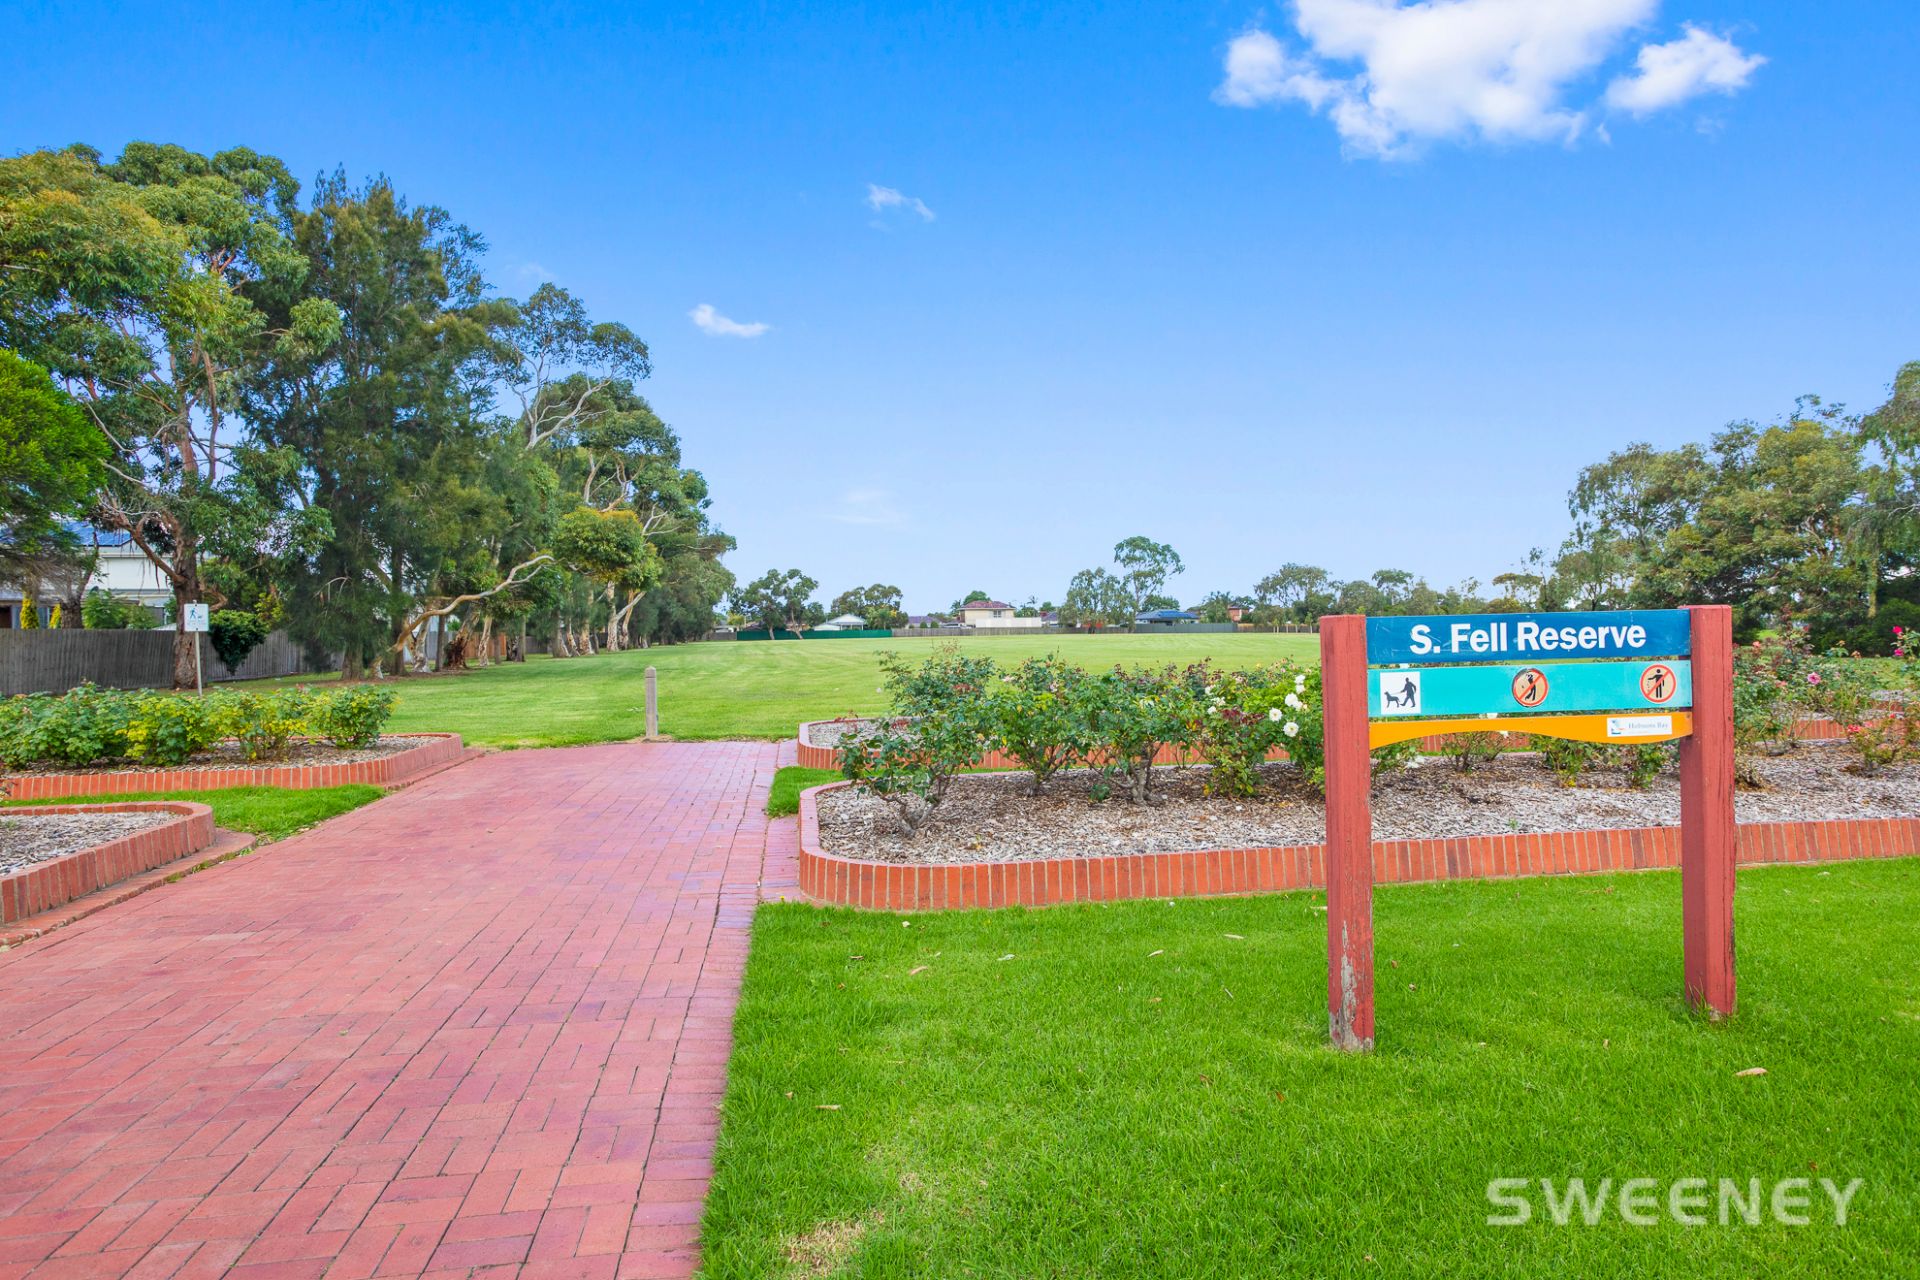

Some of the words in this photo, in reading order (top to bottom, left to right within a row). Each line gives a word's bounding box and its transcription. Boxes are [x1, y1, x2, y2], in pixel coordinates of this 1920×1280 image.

[1410, 624, 1441, 654] S.
[1451, 622, 1507, 653] Fell
[1517, 622, 1646, 651] Reserve
